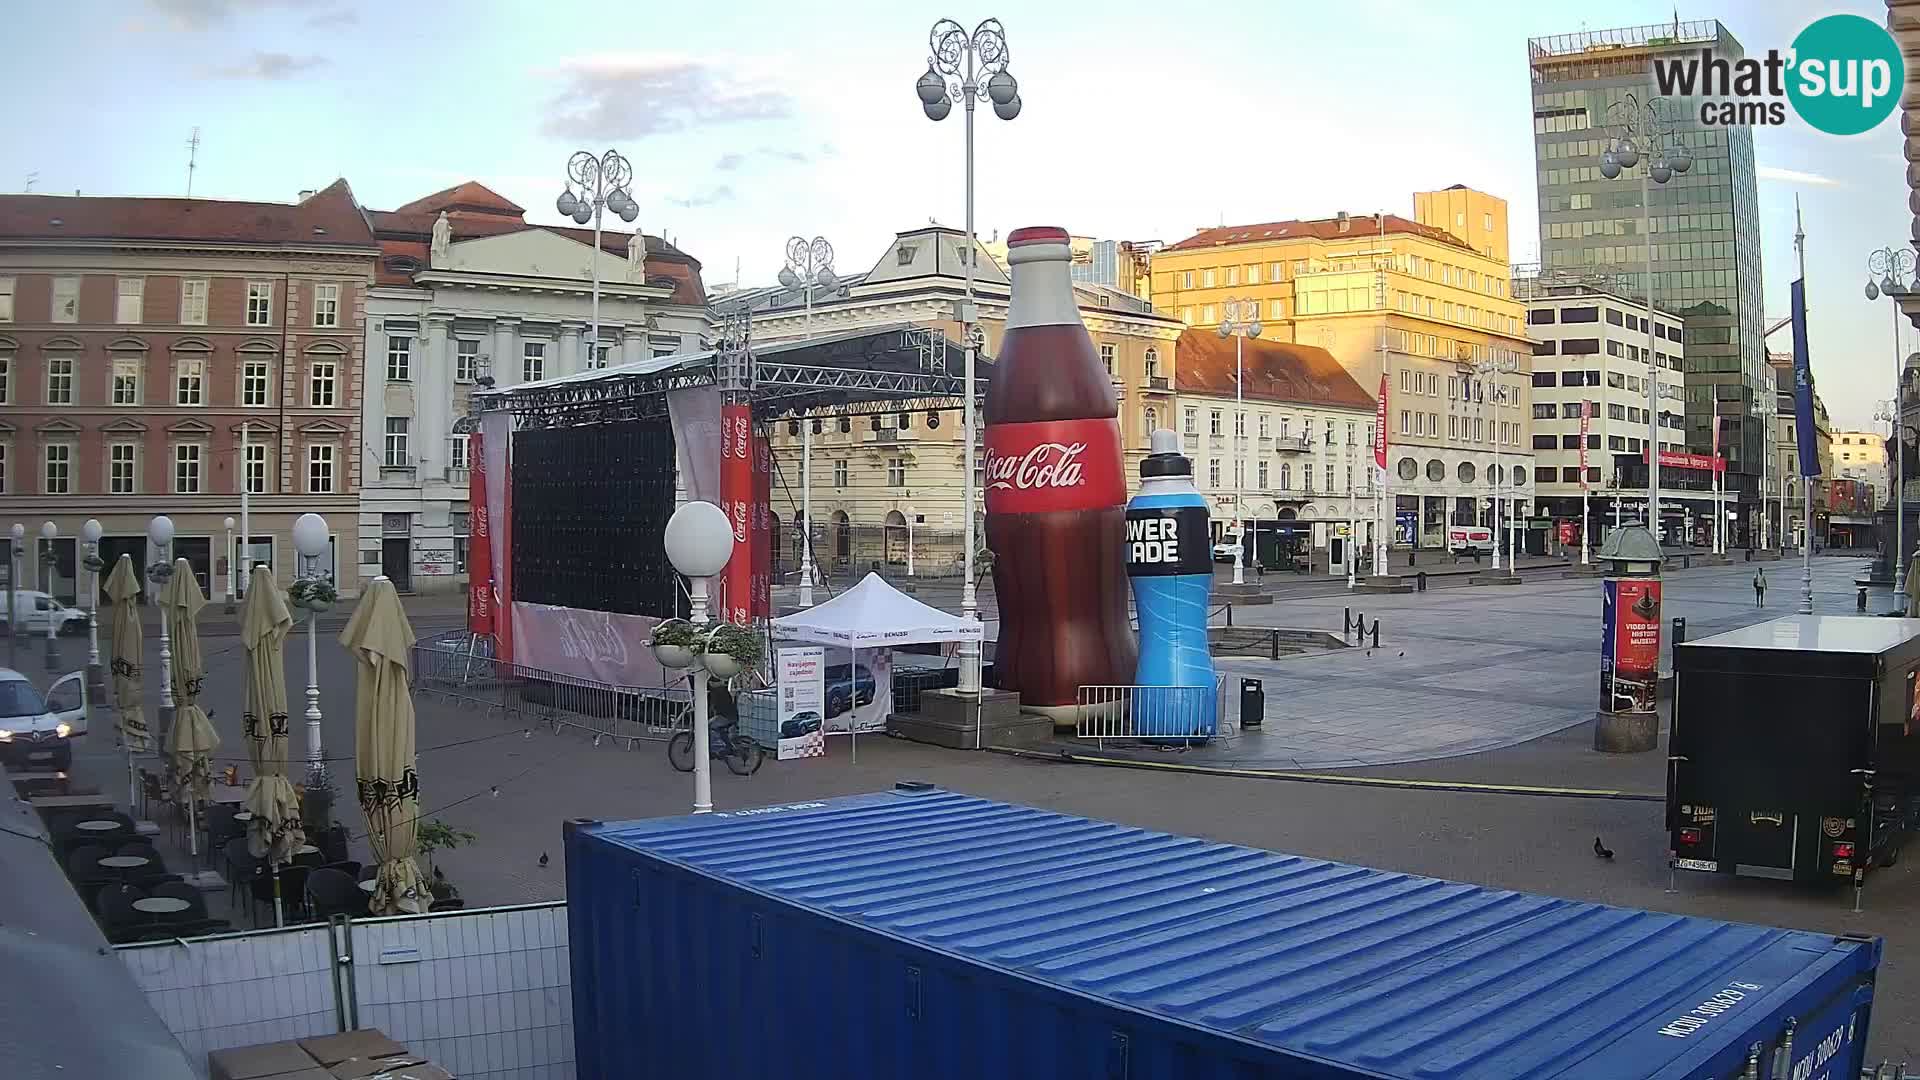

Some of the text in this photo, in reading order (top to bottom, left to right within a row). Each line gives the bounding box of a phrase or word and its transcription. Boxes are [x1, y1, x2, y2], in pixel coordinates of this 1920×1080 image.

[1125, 517, 1178, 541] WER
[1657, 1014, 1709, 1038] MCDU
[1690, 988, 1747, 1018] 300629
